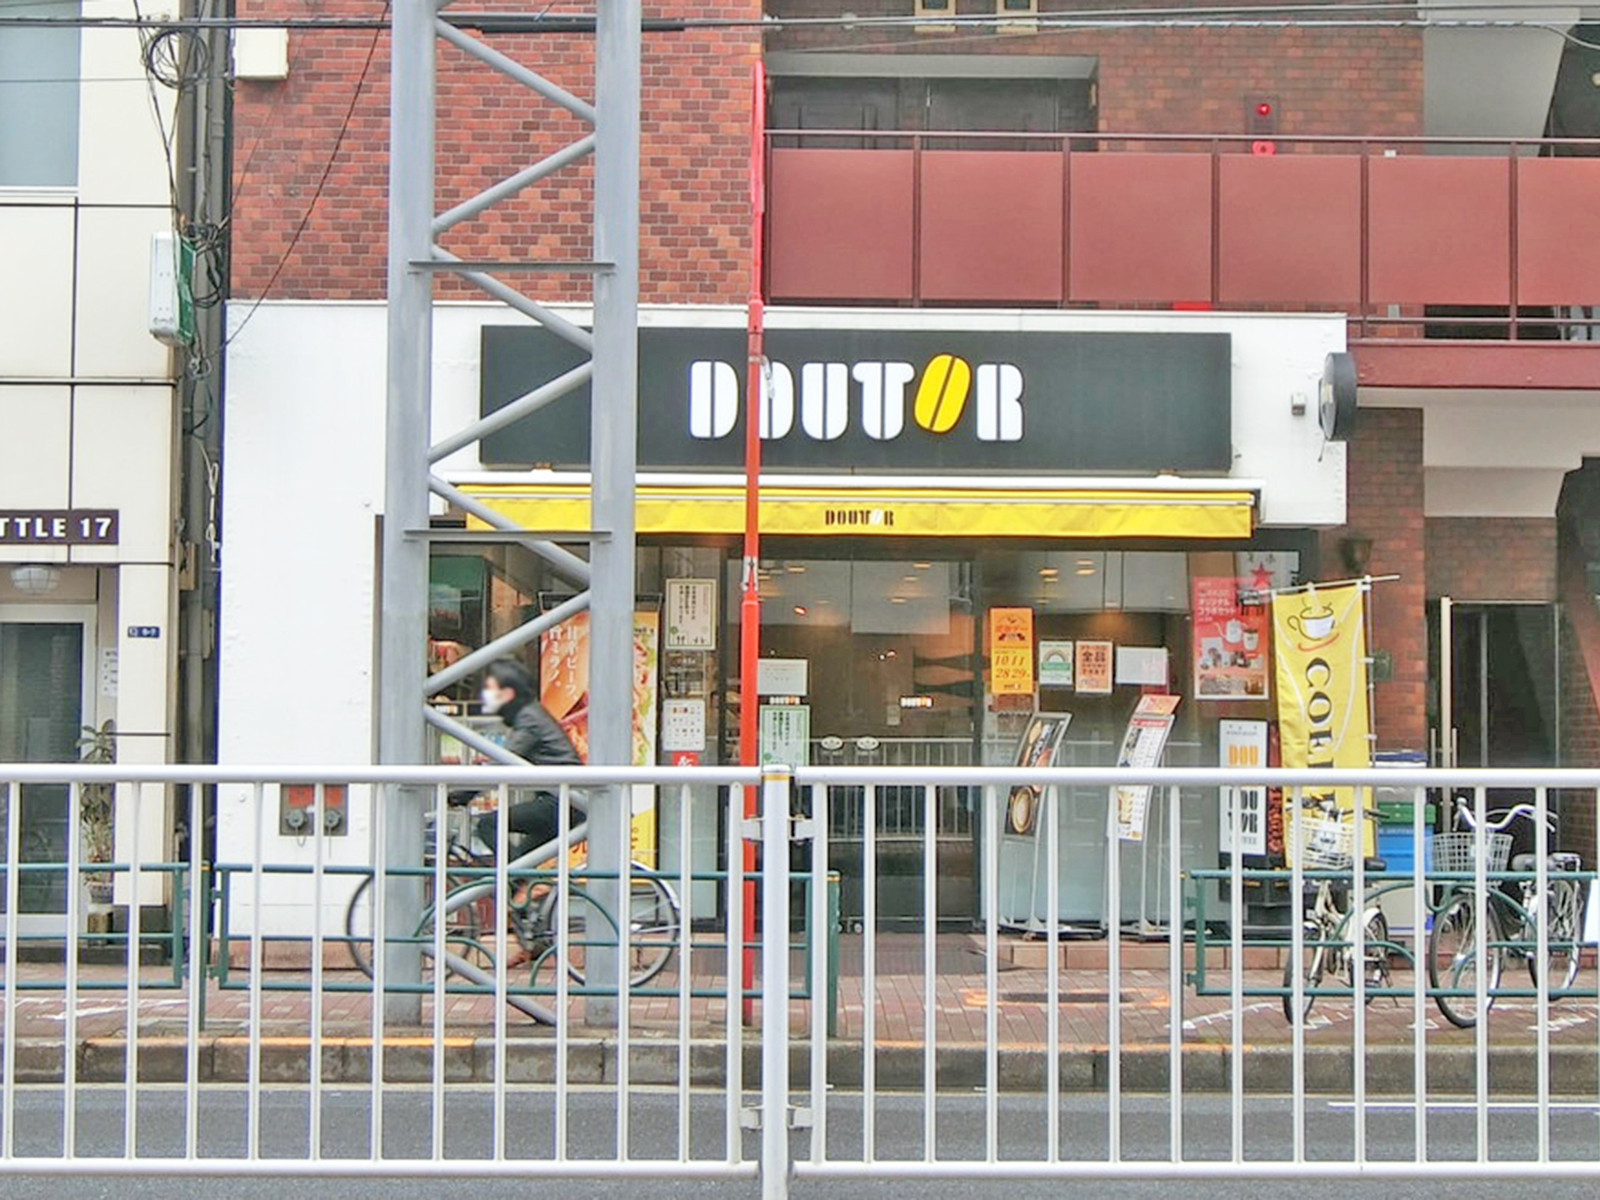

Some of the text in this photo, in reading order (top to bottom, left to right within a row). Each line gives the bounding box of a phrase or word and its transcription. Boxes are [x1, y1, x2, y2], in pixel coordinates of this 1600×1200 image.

[689, 354, 1024, 442] DOUTOR
[79, 517, 112, 538] 17
[825, 510, 894, 526] DOUTOR
